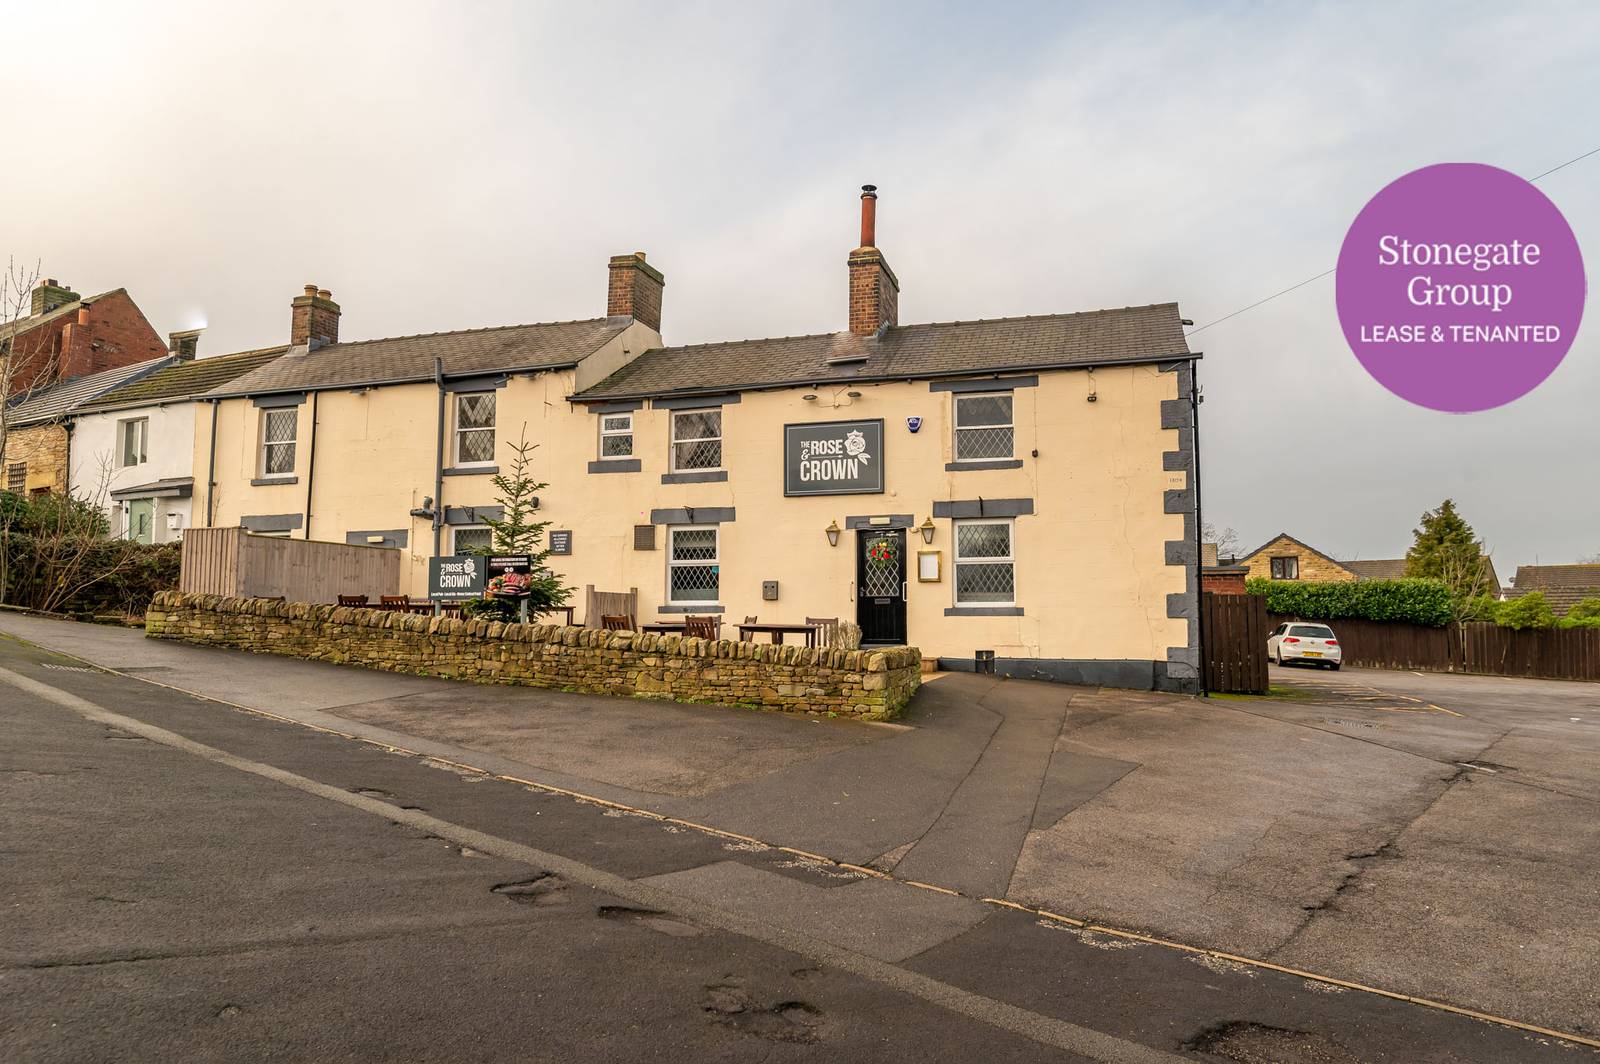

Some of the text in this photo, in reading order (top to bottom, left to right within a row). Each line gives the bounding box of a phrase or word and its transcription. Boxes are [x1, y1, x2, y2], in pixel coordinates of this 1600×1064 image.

[810, 439, 844, 455] ROSE
[801, 448, 810, 461] &
[800, 458, 859, 481] CROWN
[445, 563, 463, 572] ROSE
[440, 575, 470, 588] CROWN
